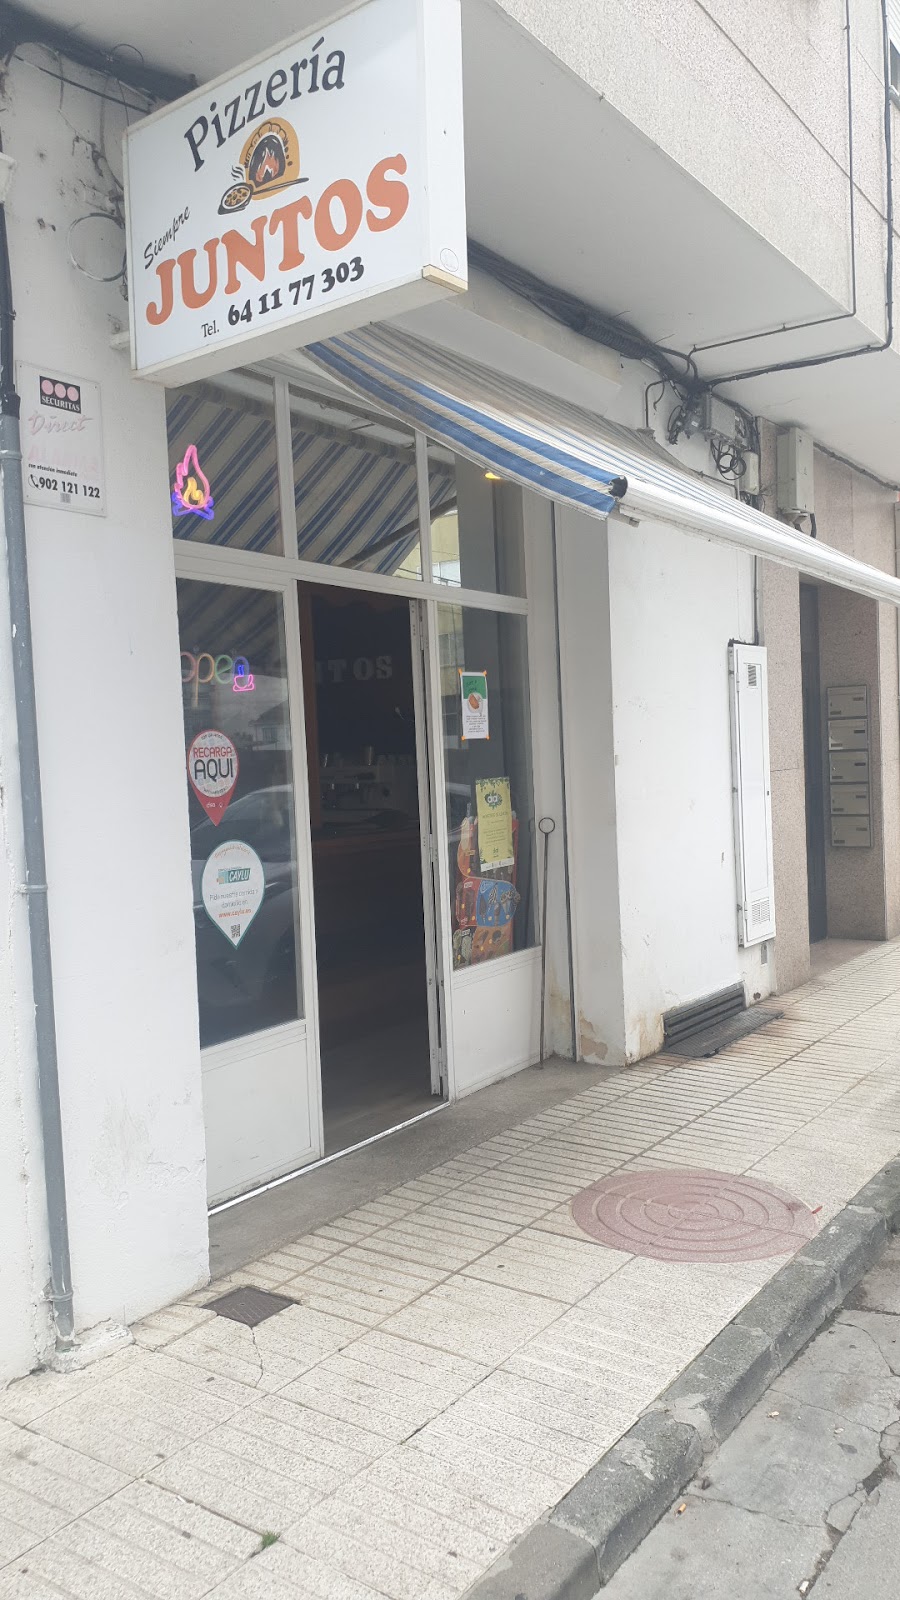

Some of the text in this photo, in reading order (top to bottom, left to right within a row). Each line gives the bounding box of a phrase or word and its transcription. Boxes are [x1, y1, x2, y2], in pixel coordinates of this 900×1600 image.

[184, 37, 345, 172] Pizzería
[144, 206, 191, 270] Siempre
[146, 153, 410, 326] JUNTOS
[201, 256, 365, 338] Tel. 64 11 77 303
[41, 396, 80, 411] SECURITAS
[39, 476, 100, 499] 902 121 122
[193, 746, 233, 758] RECARGA
[194, 758, 234, 783] AQUI
[229, 868, 249, 882] CAYLU
